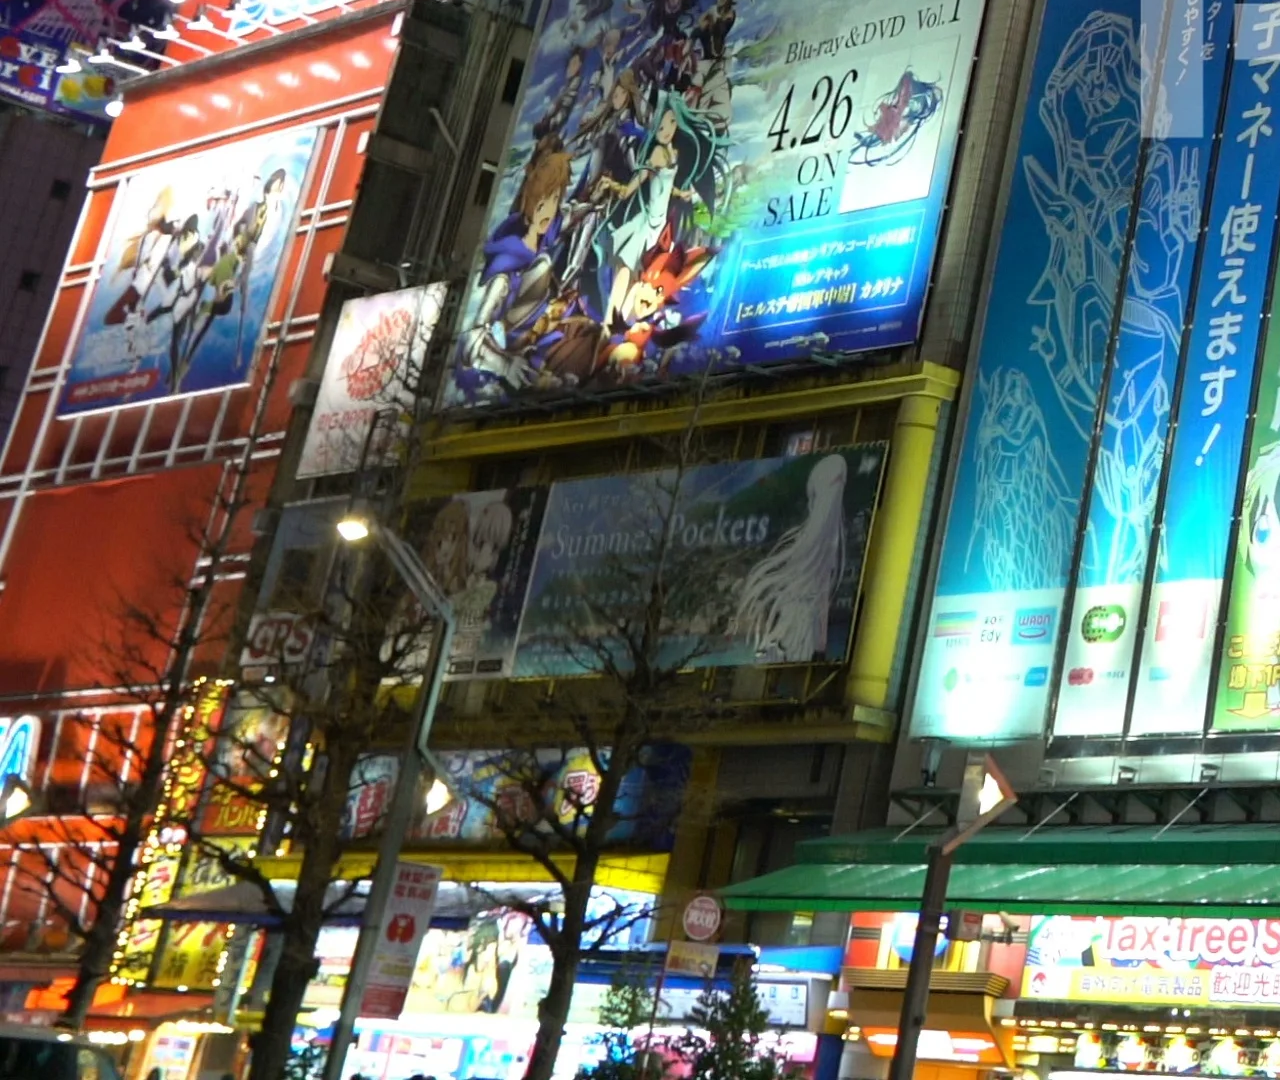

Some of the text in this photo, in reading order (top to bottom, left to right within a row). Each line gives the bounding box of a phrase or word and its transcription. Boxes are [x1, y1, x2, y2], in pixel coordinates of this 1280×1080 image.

[766, 68, 859, 155] 4.26
[797, 149, 843, 187] ON
[762, 185, 836, 229] SALE
[667, 510, 770, 549] Pockets
